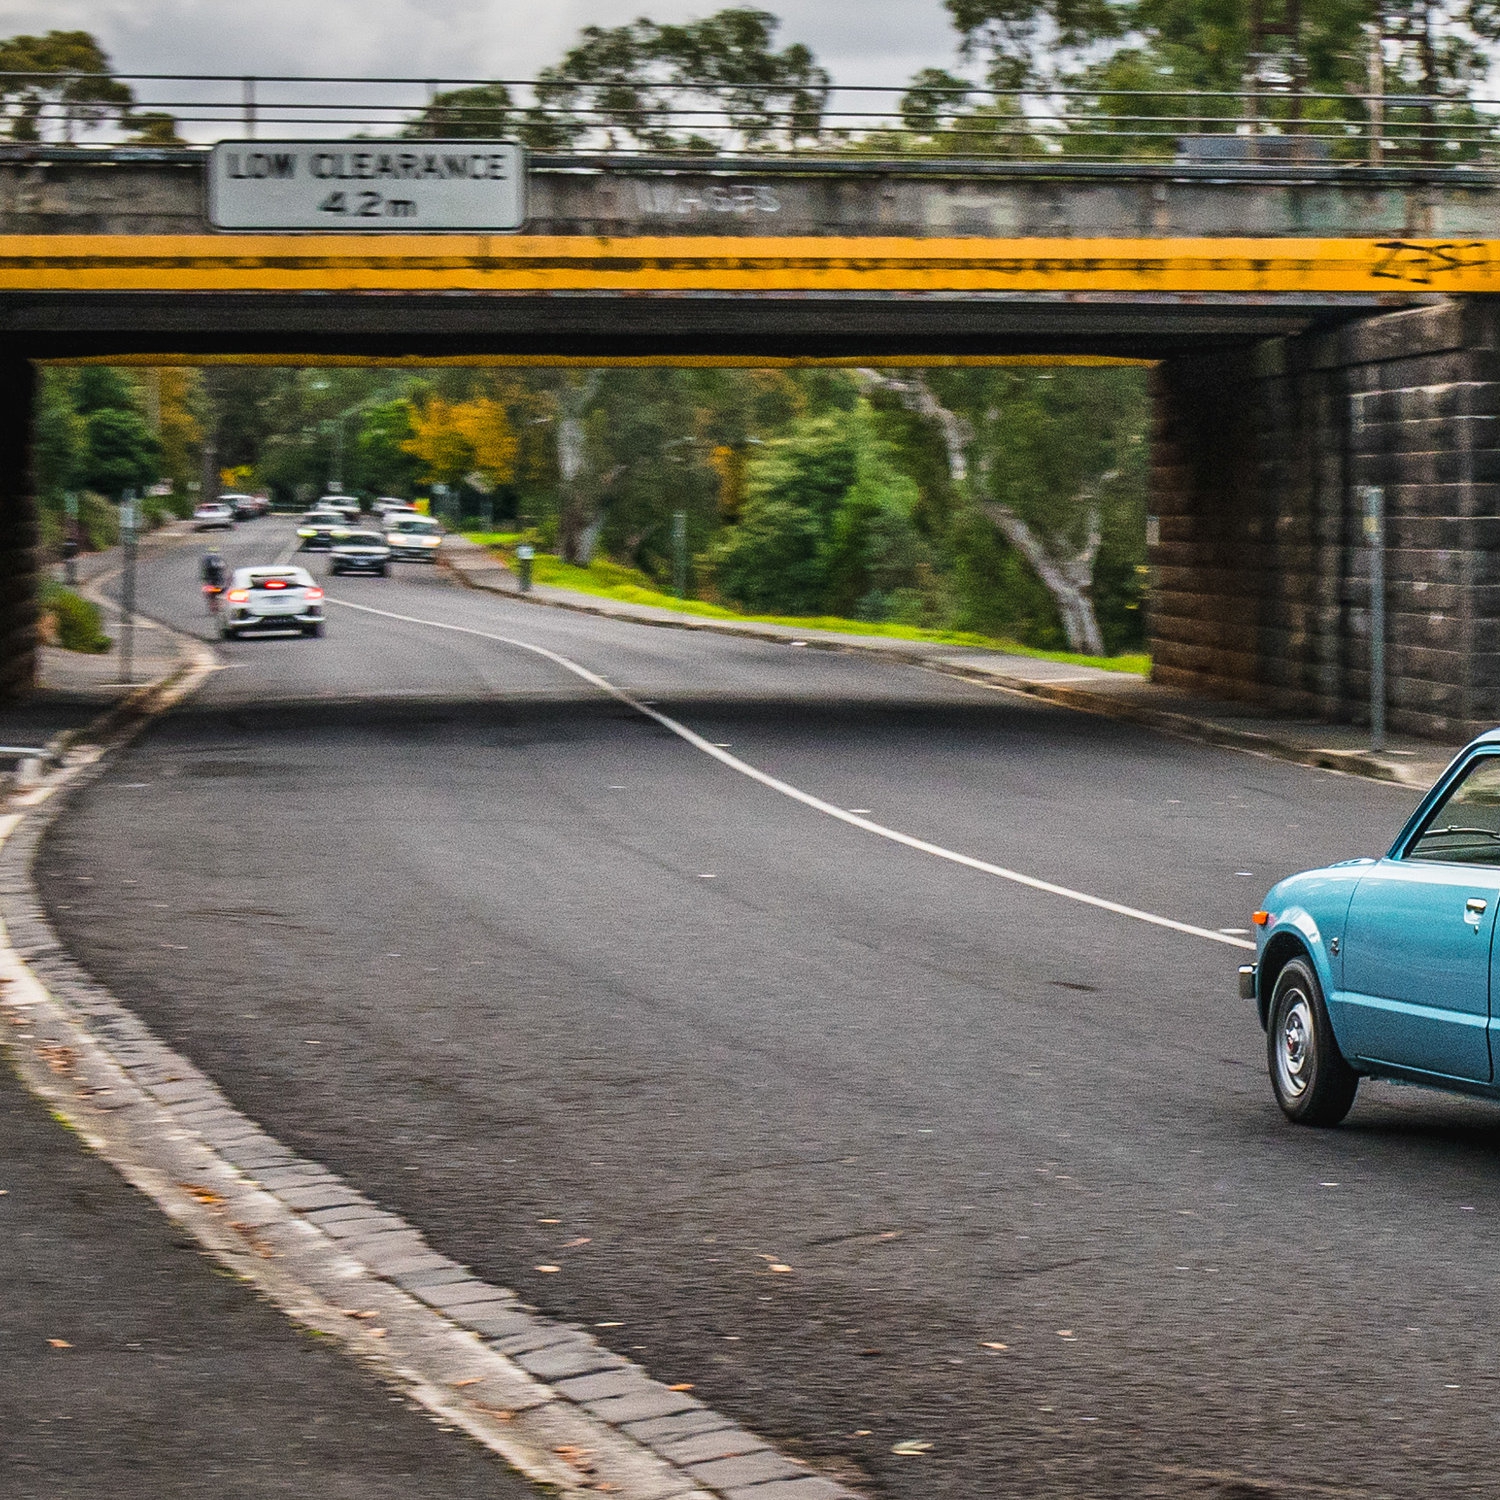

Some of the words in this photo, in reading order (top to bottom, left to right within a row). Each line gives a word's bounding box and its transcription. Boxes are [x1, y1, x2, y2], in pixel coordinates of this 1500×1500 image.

[226, 154, 296, 180] LOW
[309, 154, 508, 181] CLEARANCE
[318, 191, 418, 218] 4.2m
